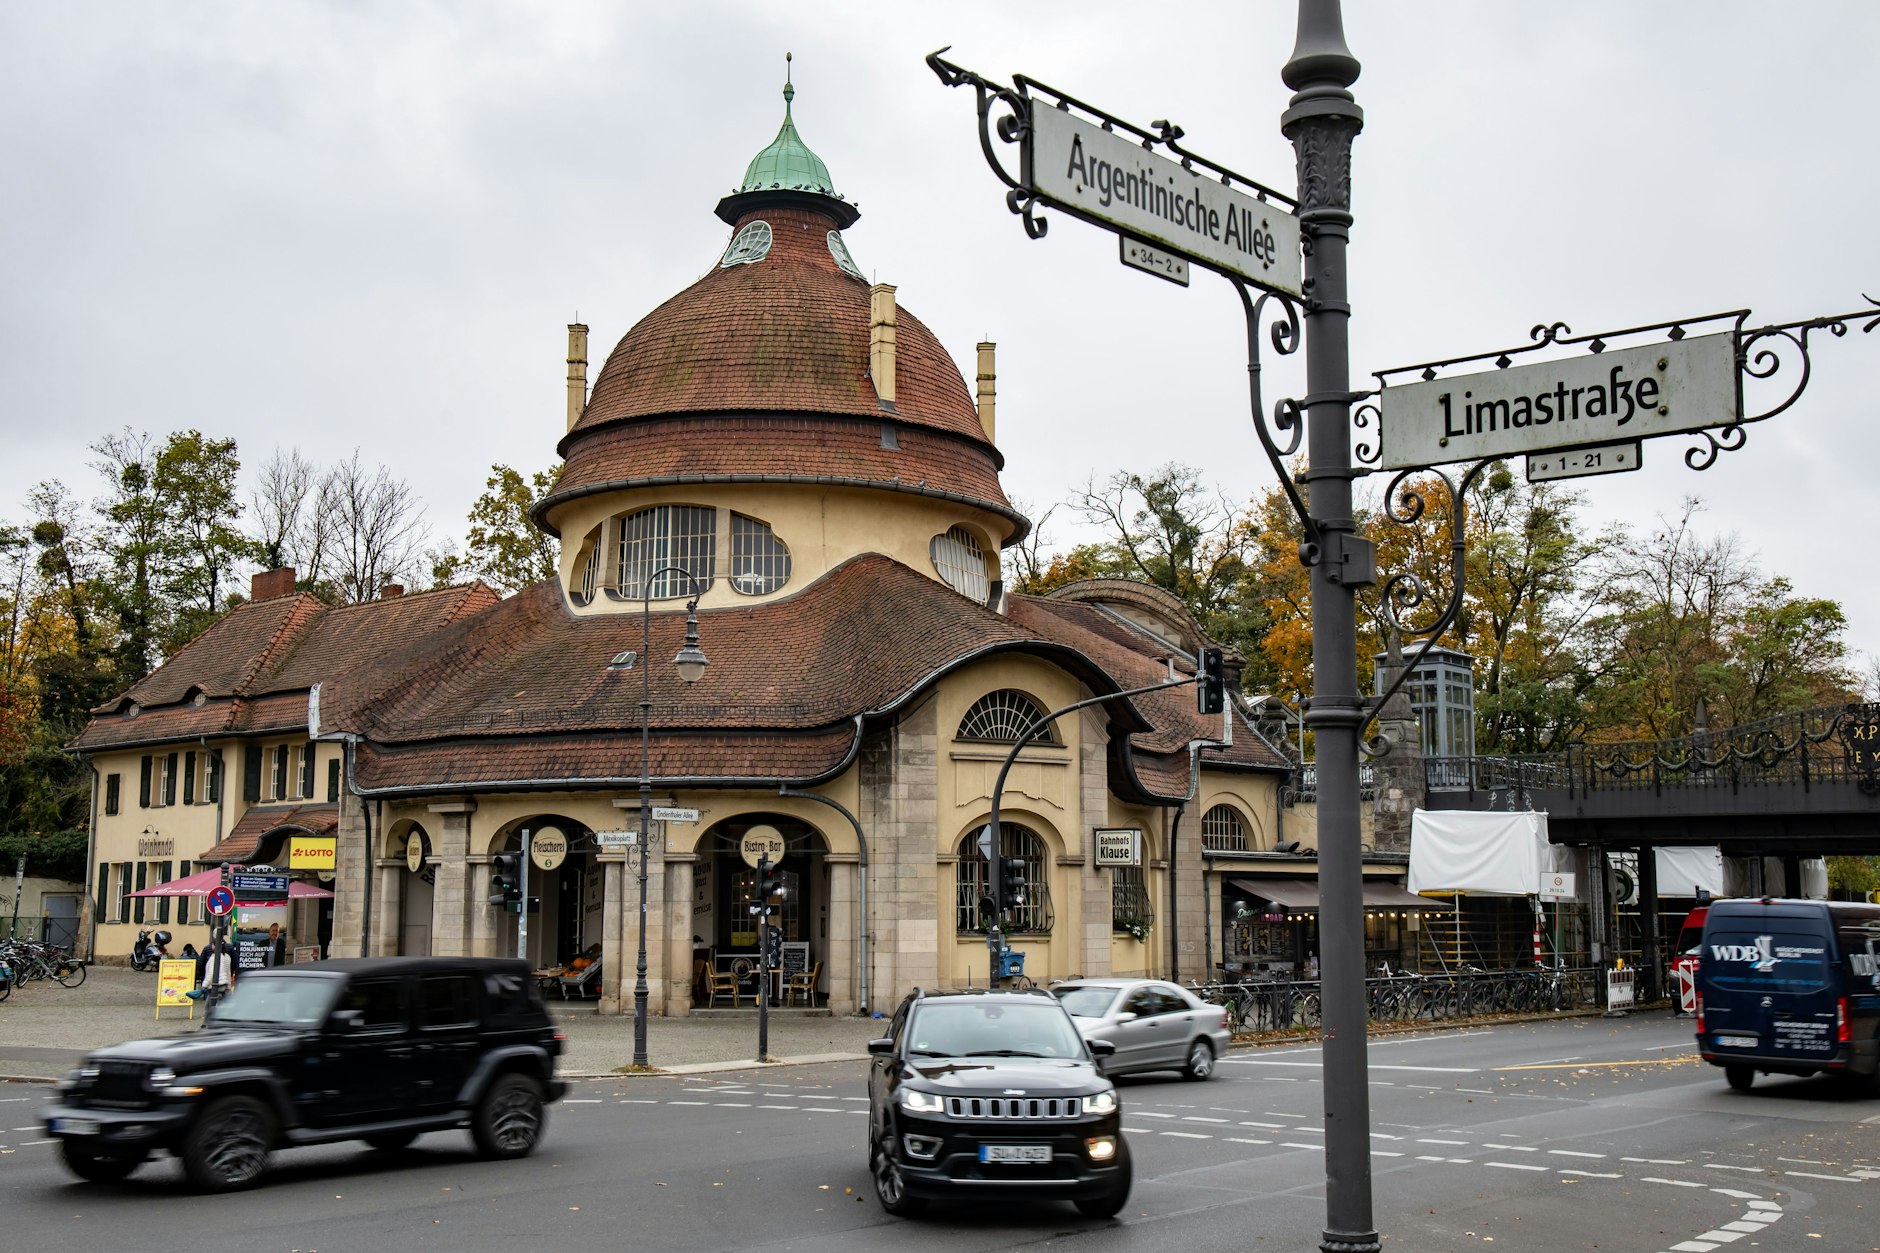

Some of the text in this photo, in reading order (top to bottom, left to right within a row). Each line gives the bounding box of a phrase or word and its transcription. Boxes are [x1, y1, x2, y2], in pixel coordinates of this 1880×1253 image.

[1067, 133, 1276, 265] Argentinische Allee
[1443, 366, 1659, 438] Limastraße
[656, 809, 694, 819] Lindenthaler Allee
[602, 834, 631, 844] Mexikoplatz
[1100, 836, 1130, 845] Bahnhofs
[138, 837, 175, 857] Weinhandel
[533, 841, 565, 853] Fleischerei
[744, 841, 765, 852] Bistro
[769, 841, 783, 852] Bar
[1100, 846, 1130, 858] Klause
[304, 849, 334, 857] LOTTO
[693, 903, 712, 915] emüse
[1710, 945, 1760, 962] WDB
